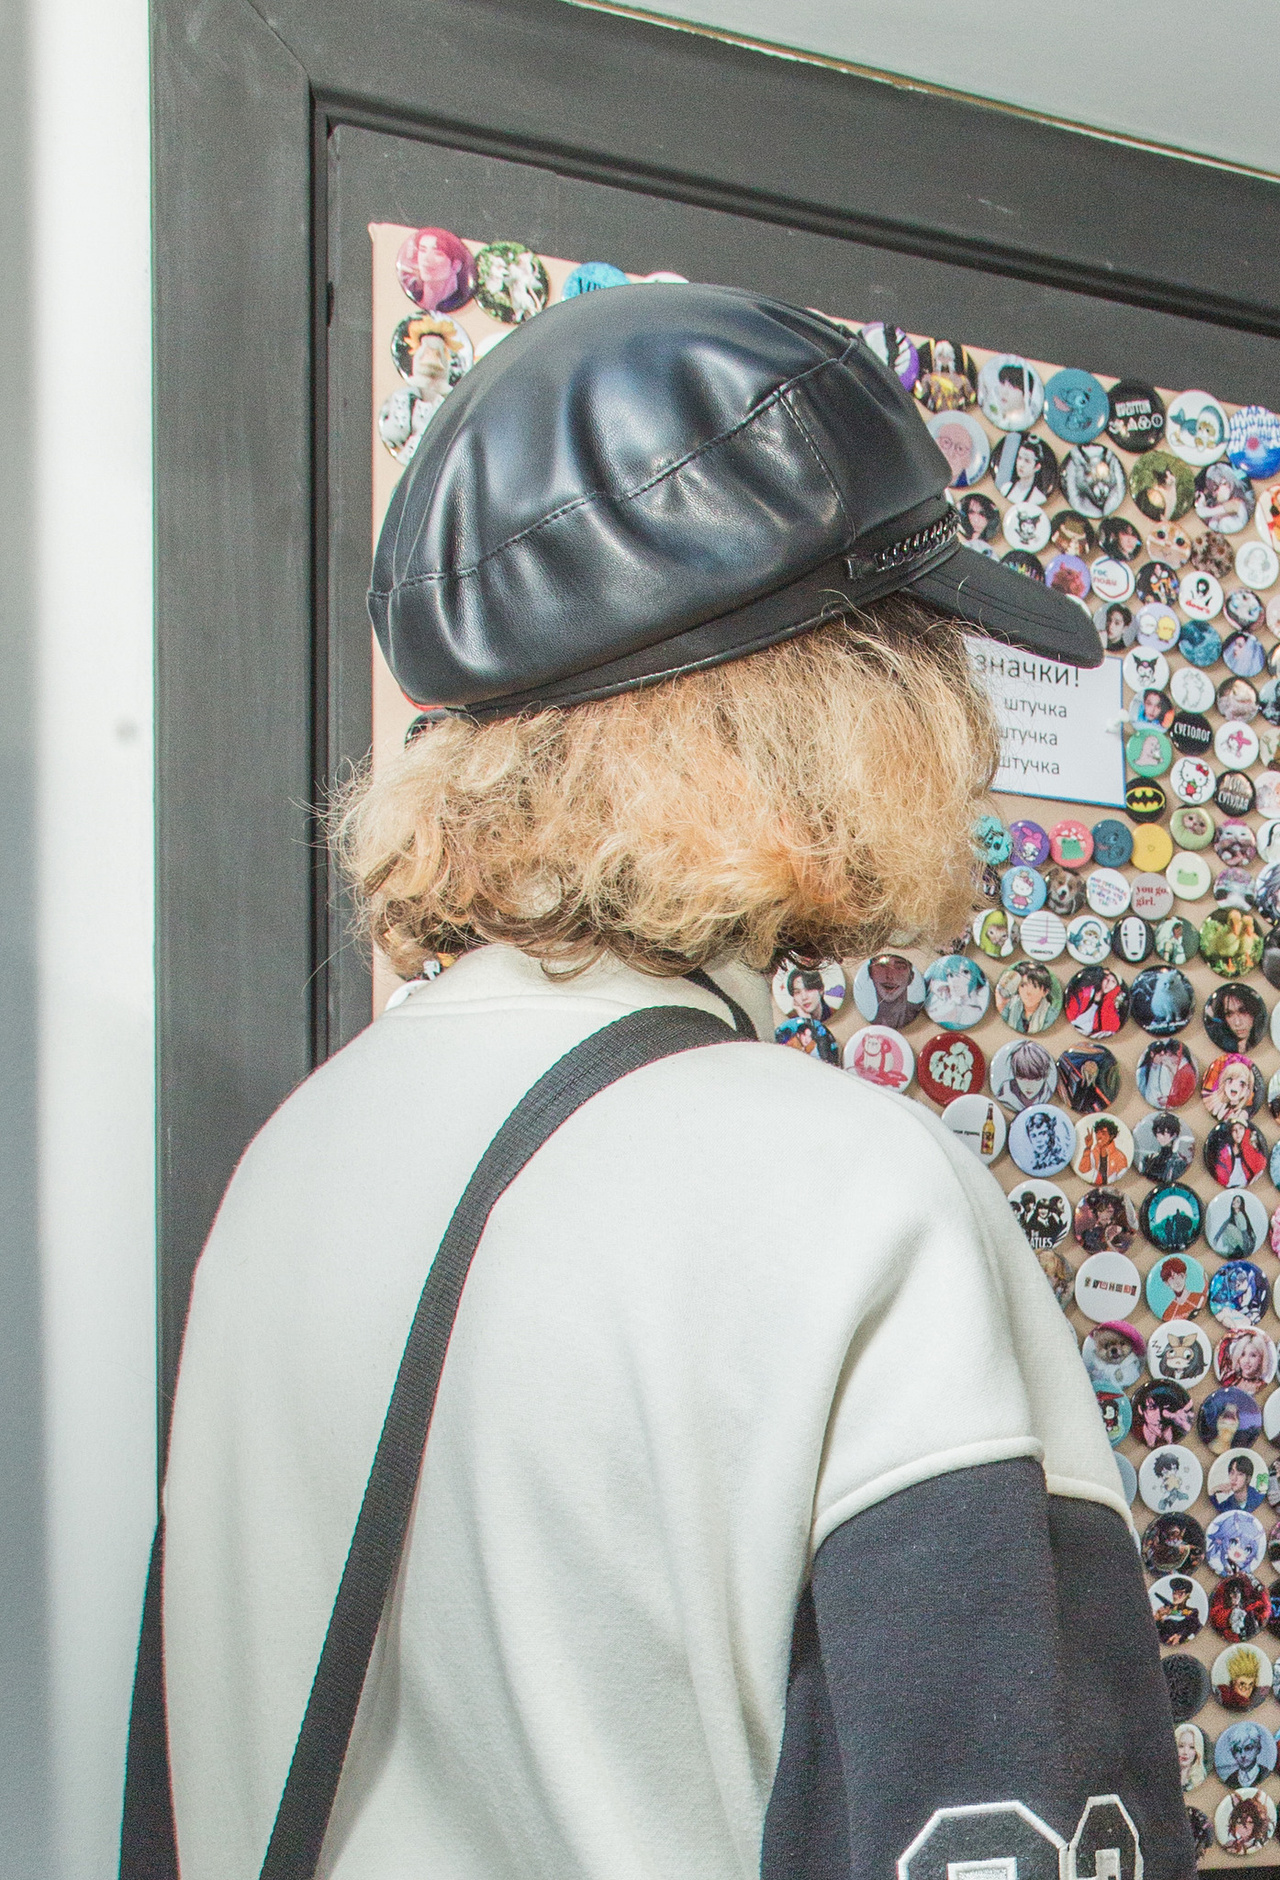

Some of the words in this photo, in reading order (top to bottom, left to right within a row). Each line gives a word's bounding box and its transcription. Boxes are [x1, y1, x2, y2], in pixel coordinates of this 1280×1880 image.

[974, 654, 1080, 687] значки!
[1004, 697, 1068, 719] штучка
[1173, 720, 1212, 743] СУЕТОЛОГ
[1136, 886, 1154, 898] you
